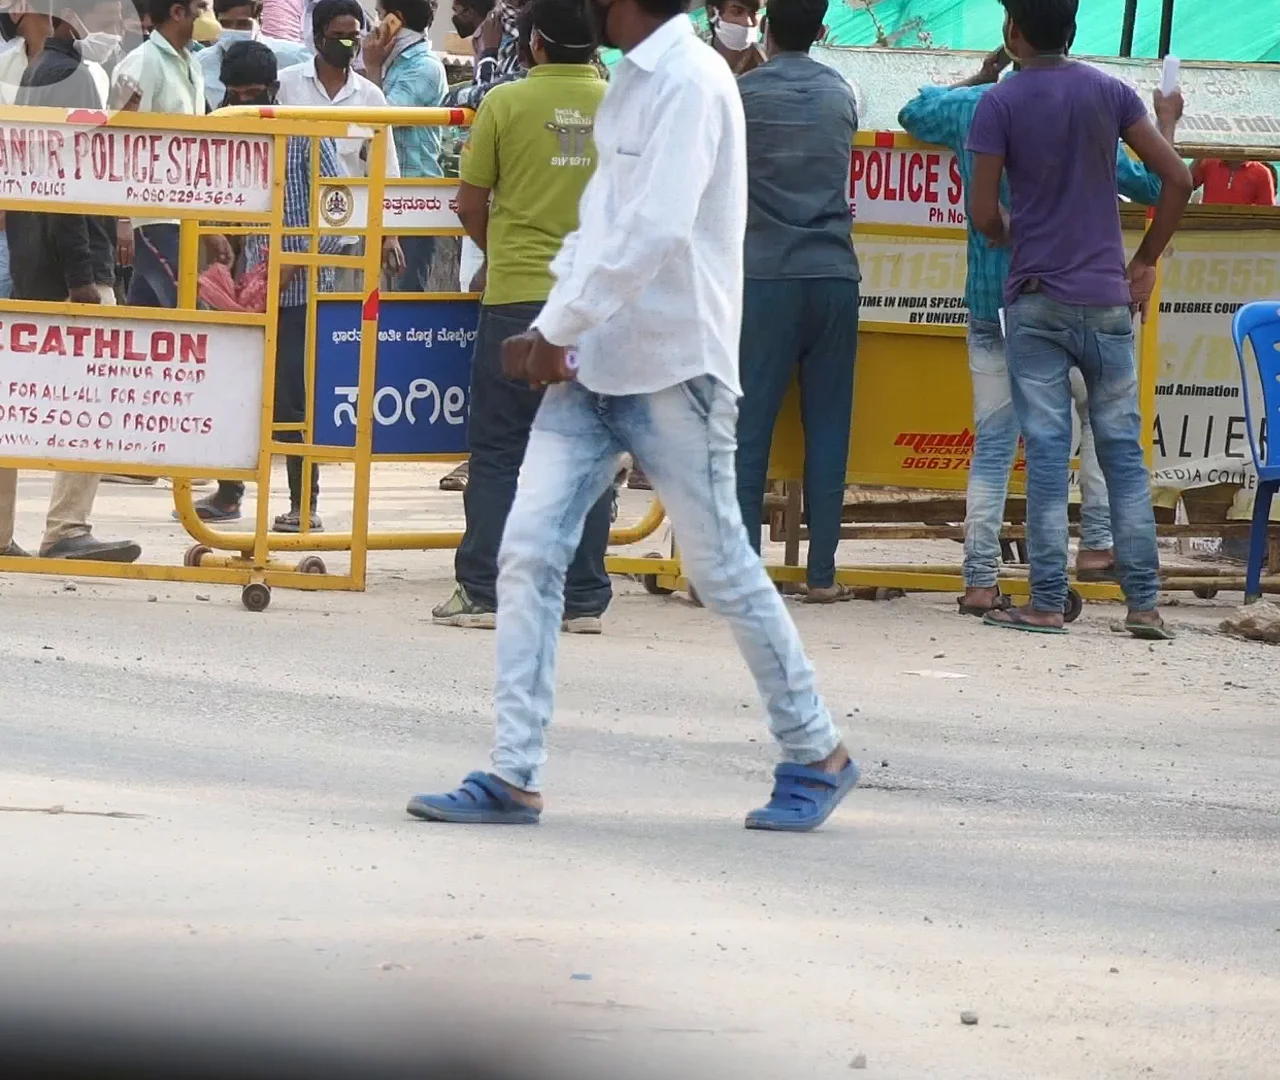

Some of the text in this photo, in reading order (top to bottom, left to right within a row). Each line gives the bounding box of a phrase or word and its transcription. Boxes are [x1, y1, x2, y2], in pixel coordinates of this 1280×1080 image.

[73, 131, 163, 185] POLICE
[166, 136, 270, 190] STATION
[849, 150, 940, 203] POLICE
[30, 181, 67, 197] POLICE
[929, 207, 944, 223] Ph
[884, 296, 897, 308] IN
[897, 296, 928, 308] INDIA
[929, 297, 968, 309] SPECIA
[1172, 302, 1213, 314] DEGREE
[909, 312, 969, 324] BY UNIVER
[86, 363, 206, 384] HENNUR ROAD
[8, 381, 37, 399] FOR
[110, 387, 136, 404] FOR
[142, 388, 196, 407] SPORT
[1175, 384, 1239, 398] Animation
[333, 378, 471, 428] ಸಂಗೀ
[41, 408, 114, 429] 5000
[123, 412, 214, 434] PRODUCTS
[920, 446, 972, 456] STICKER
